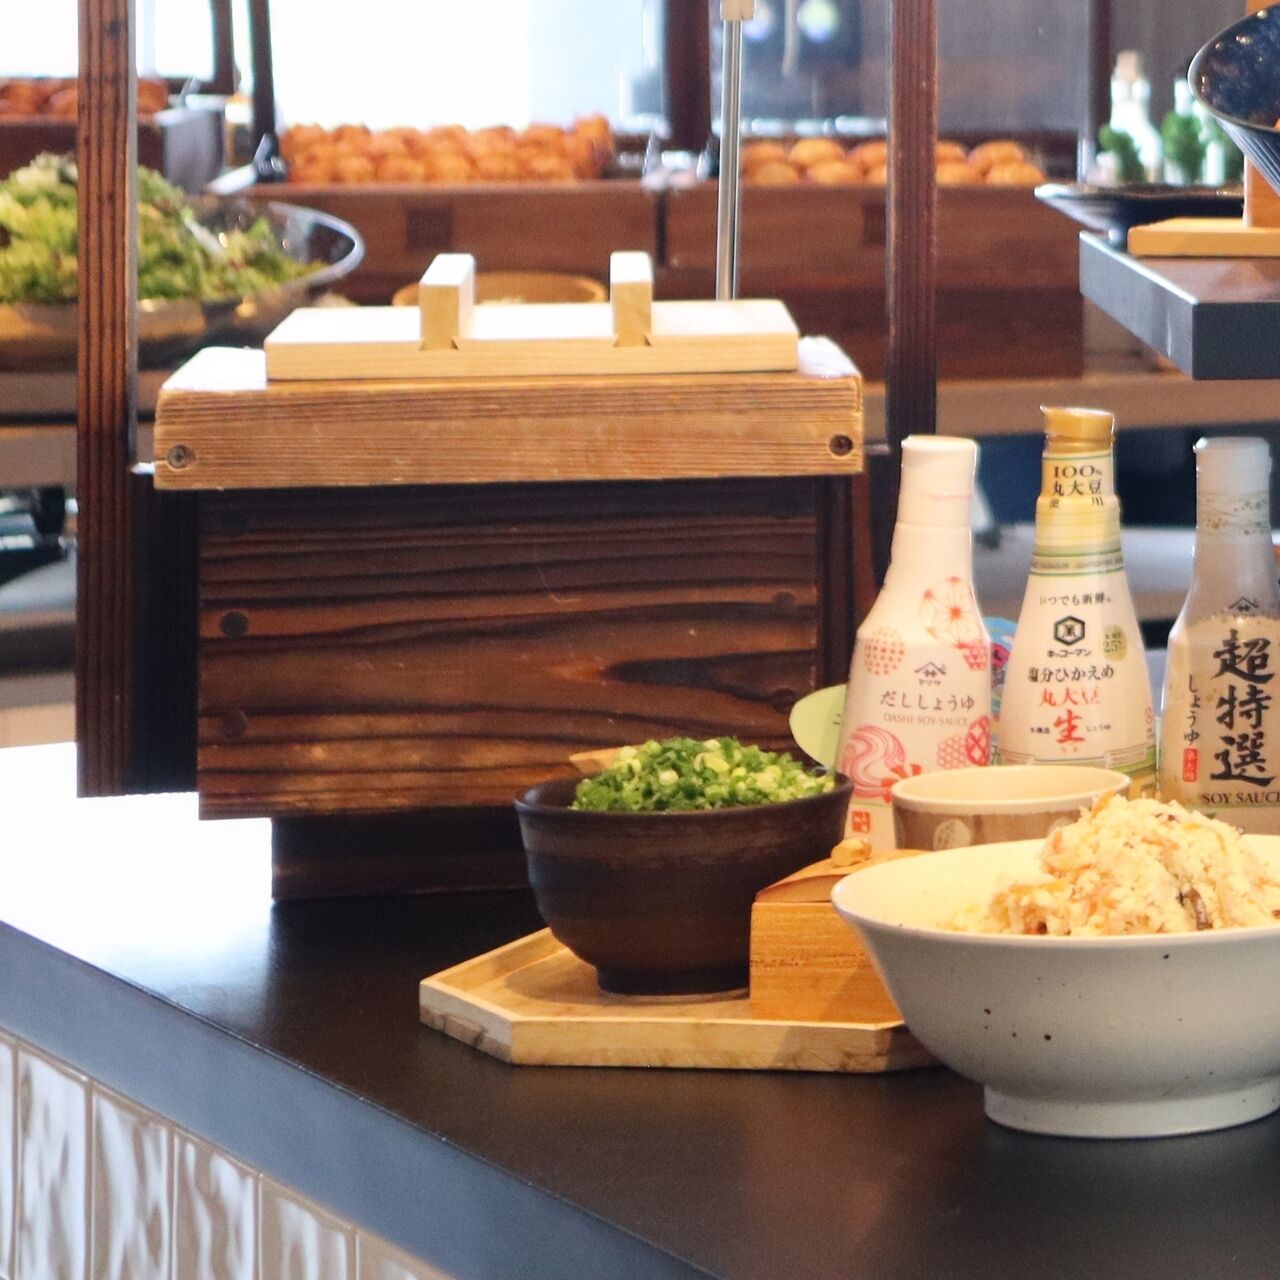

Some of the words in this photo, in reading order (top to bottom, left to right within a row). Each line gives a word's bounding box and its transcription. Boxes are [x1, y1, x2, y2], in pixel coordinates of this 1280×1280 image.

[1028, 664, 1115, 683] 塩分ひかえめ
[880, 690, 975, 712] だししょうゆ
[1183, 674, 1201, 746] しょうゆ
[1210, 628, 1276, 787] 超特選
[1053, 708, 1086, 744] 生
[1202, 792, 1233, 805] SOY
